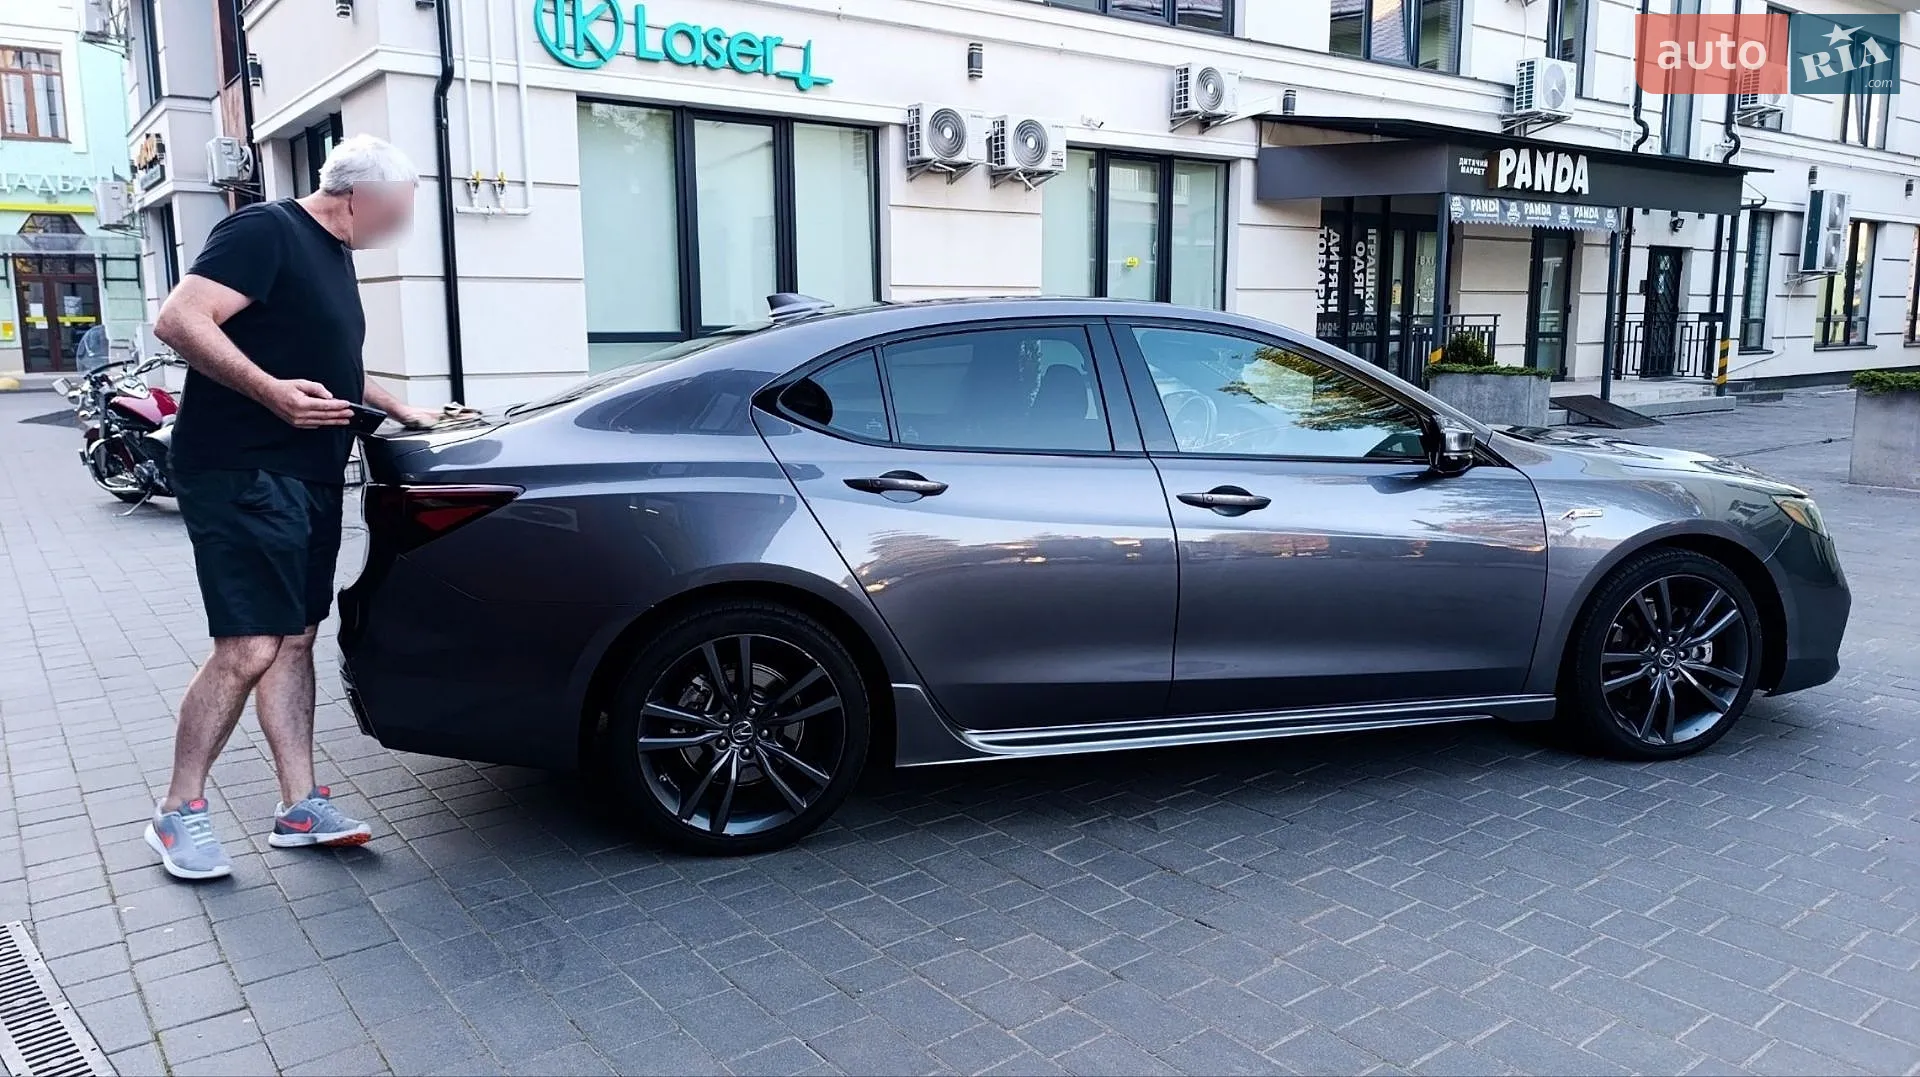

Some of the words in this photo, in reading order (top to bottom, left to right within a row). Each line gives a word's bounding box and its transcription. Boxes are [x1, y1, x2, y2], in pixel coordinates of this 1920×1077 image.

[635, 4, 783, 75] Laser
[1497, 147, 1589, 194] PANDA
[1524, 202, 1552, 217] PANDA
[1573, 206, 1600, 219] PANDA
[1353, 240, 1366, 300] ОДЯГ
